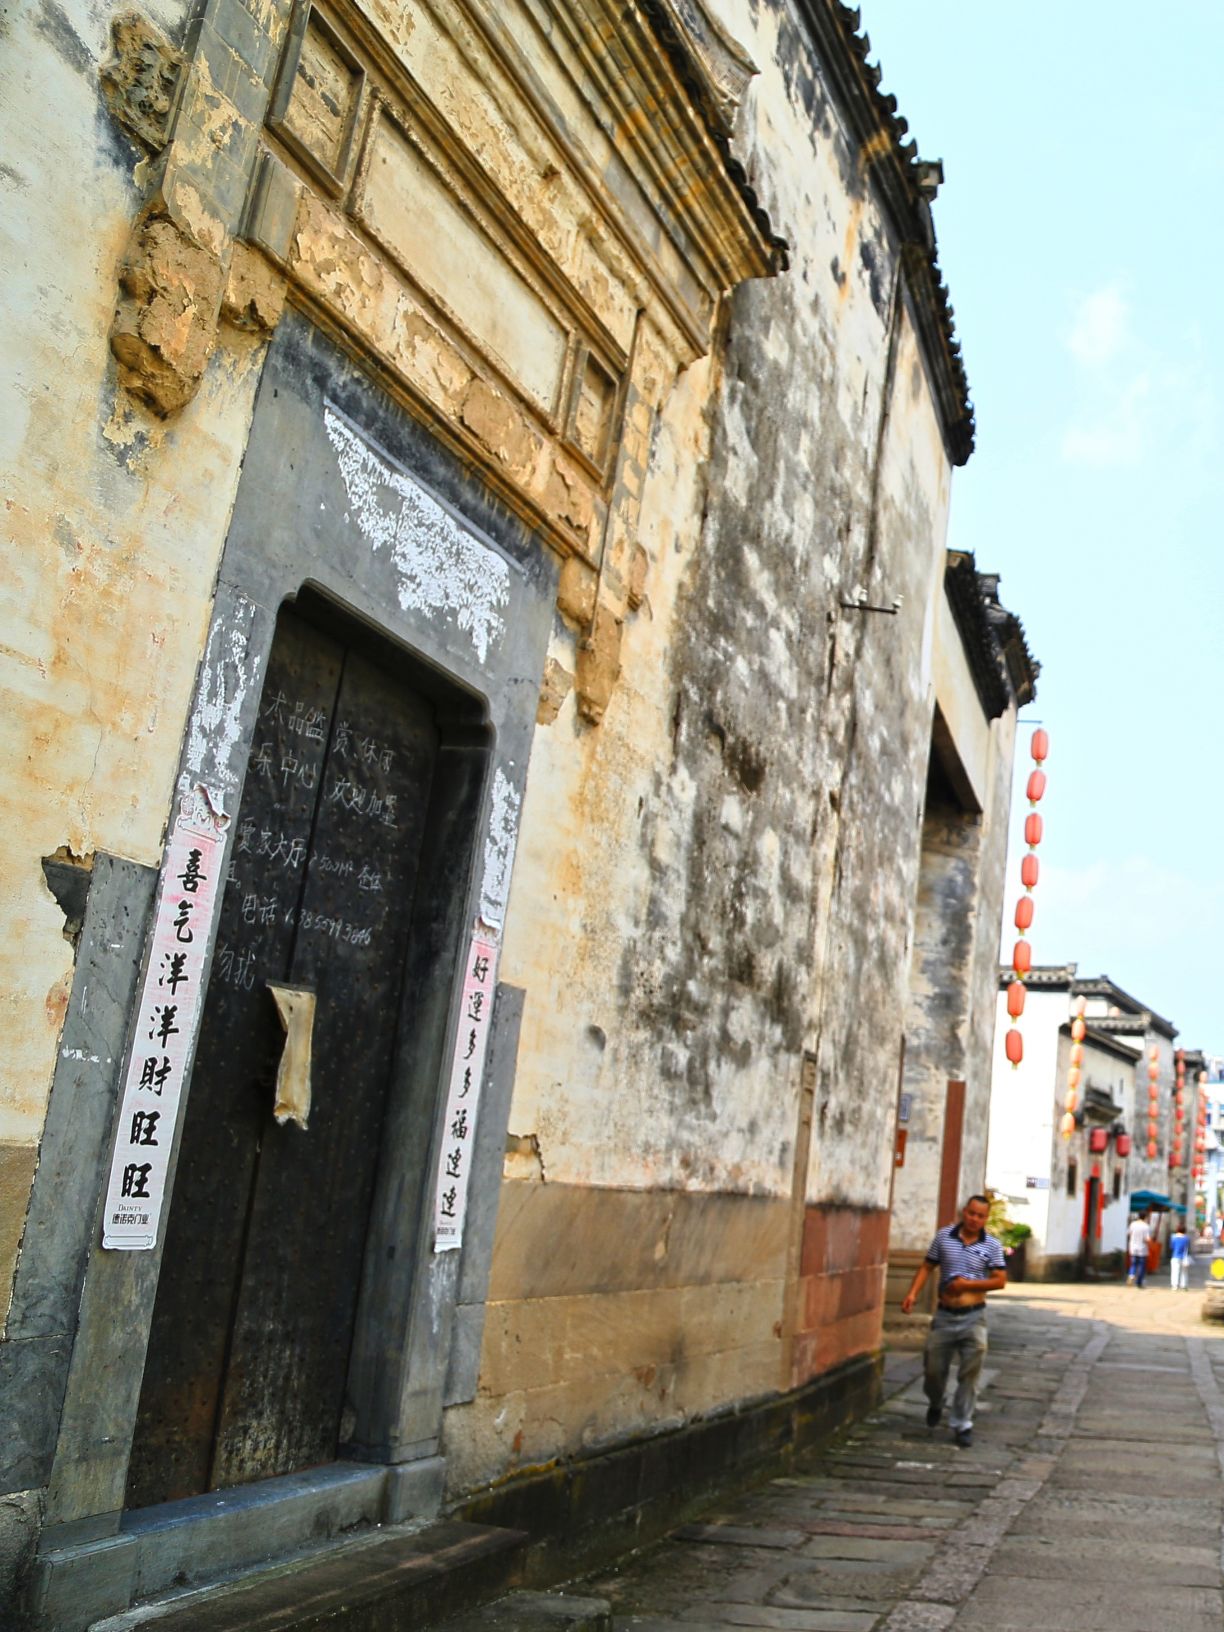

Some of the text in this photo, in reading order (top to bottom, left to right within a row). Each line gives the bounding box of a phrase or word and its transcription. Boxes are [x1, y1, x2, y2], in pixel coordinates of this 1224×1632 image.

[248, 742, 317, 789] 乐中心
[242, 893, 278, 925] 电话
